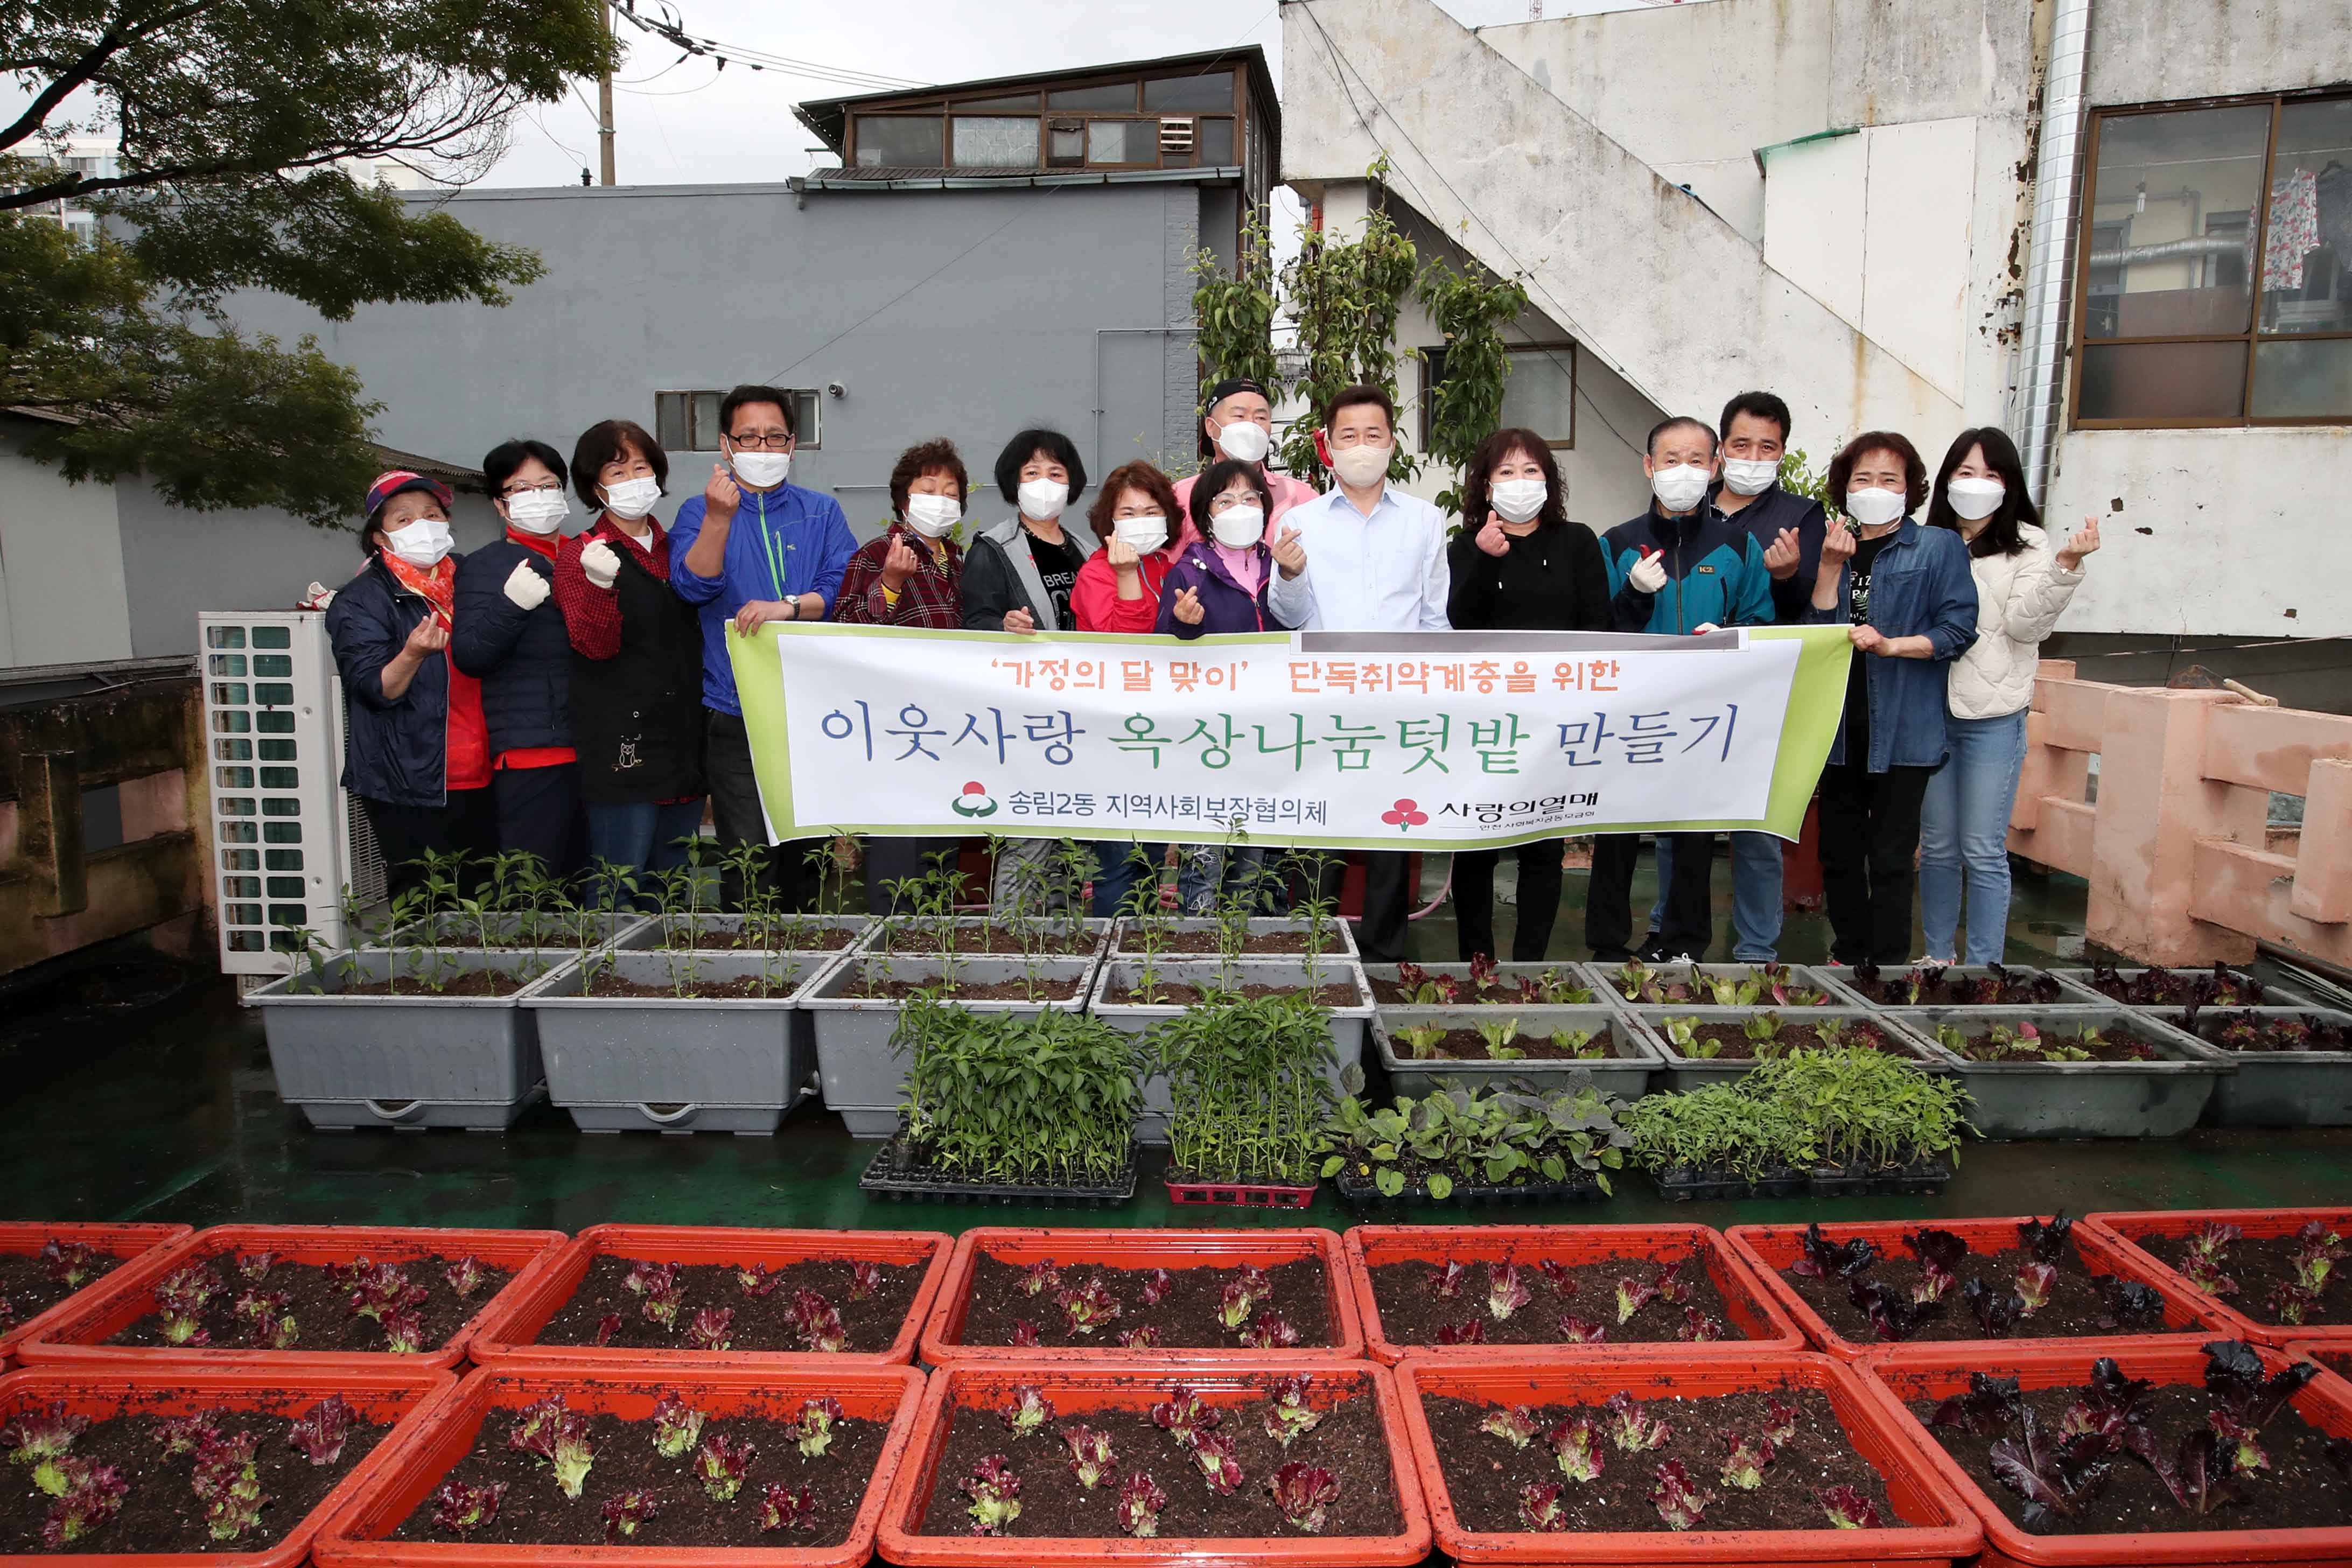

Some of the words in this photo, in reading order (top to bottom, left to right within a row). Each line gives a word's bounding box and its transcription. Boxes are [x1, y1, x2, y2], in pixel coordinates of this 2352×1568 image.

[1123, 661, 1153, 691] 달
[1290, 661, 1537, 694] 단독취약계층을
[1553, 660, 1620, 691] 위한
[821, 700, 1086, 765] 이웃사랑
[1109, 712, 1529, 774] 옥상나눔텃밭
[1557, 704, 1738, 767] 만들기
[1009, 790, 1096, 816] 송림2동
[1107, 794, 1326, 825] 지역사회보장협의체
[1438, 792, 1598, 823] 사랑의열매
